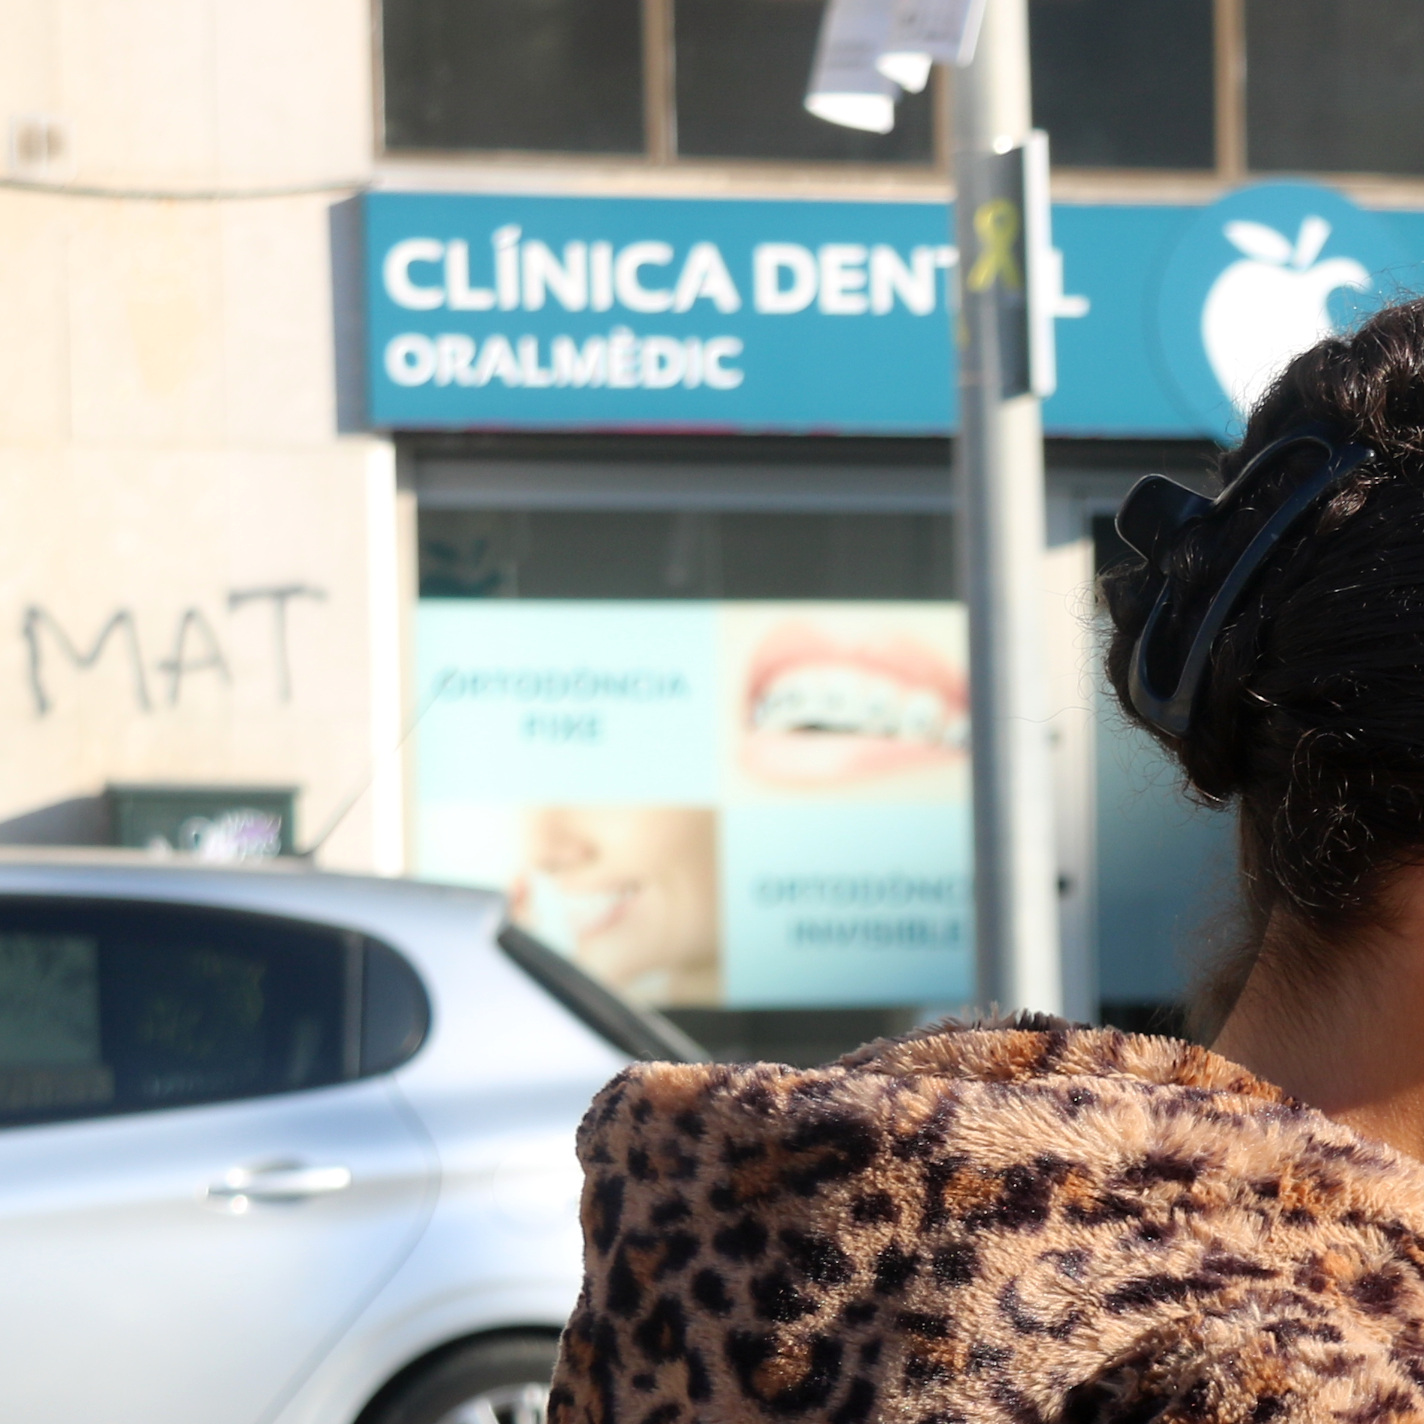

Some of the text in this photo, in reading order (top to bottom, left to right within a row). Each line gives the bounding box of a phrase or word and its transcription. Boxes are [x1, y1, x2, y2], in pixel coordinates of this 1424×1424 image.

[377, 223, 1091, 319] CLÍNICA DENL
[22, 581, 329, 719] MAT
[521, 712, 604, 742] FIXE
[791, 917, 964, 947] INVISIBLE
